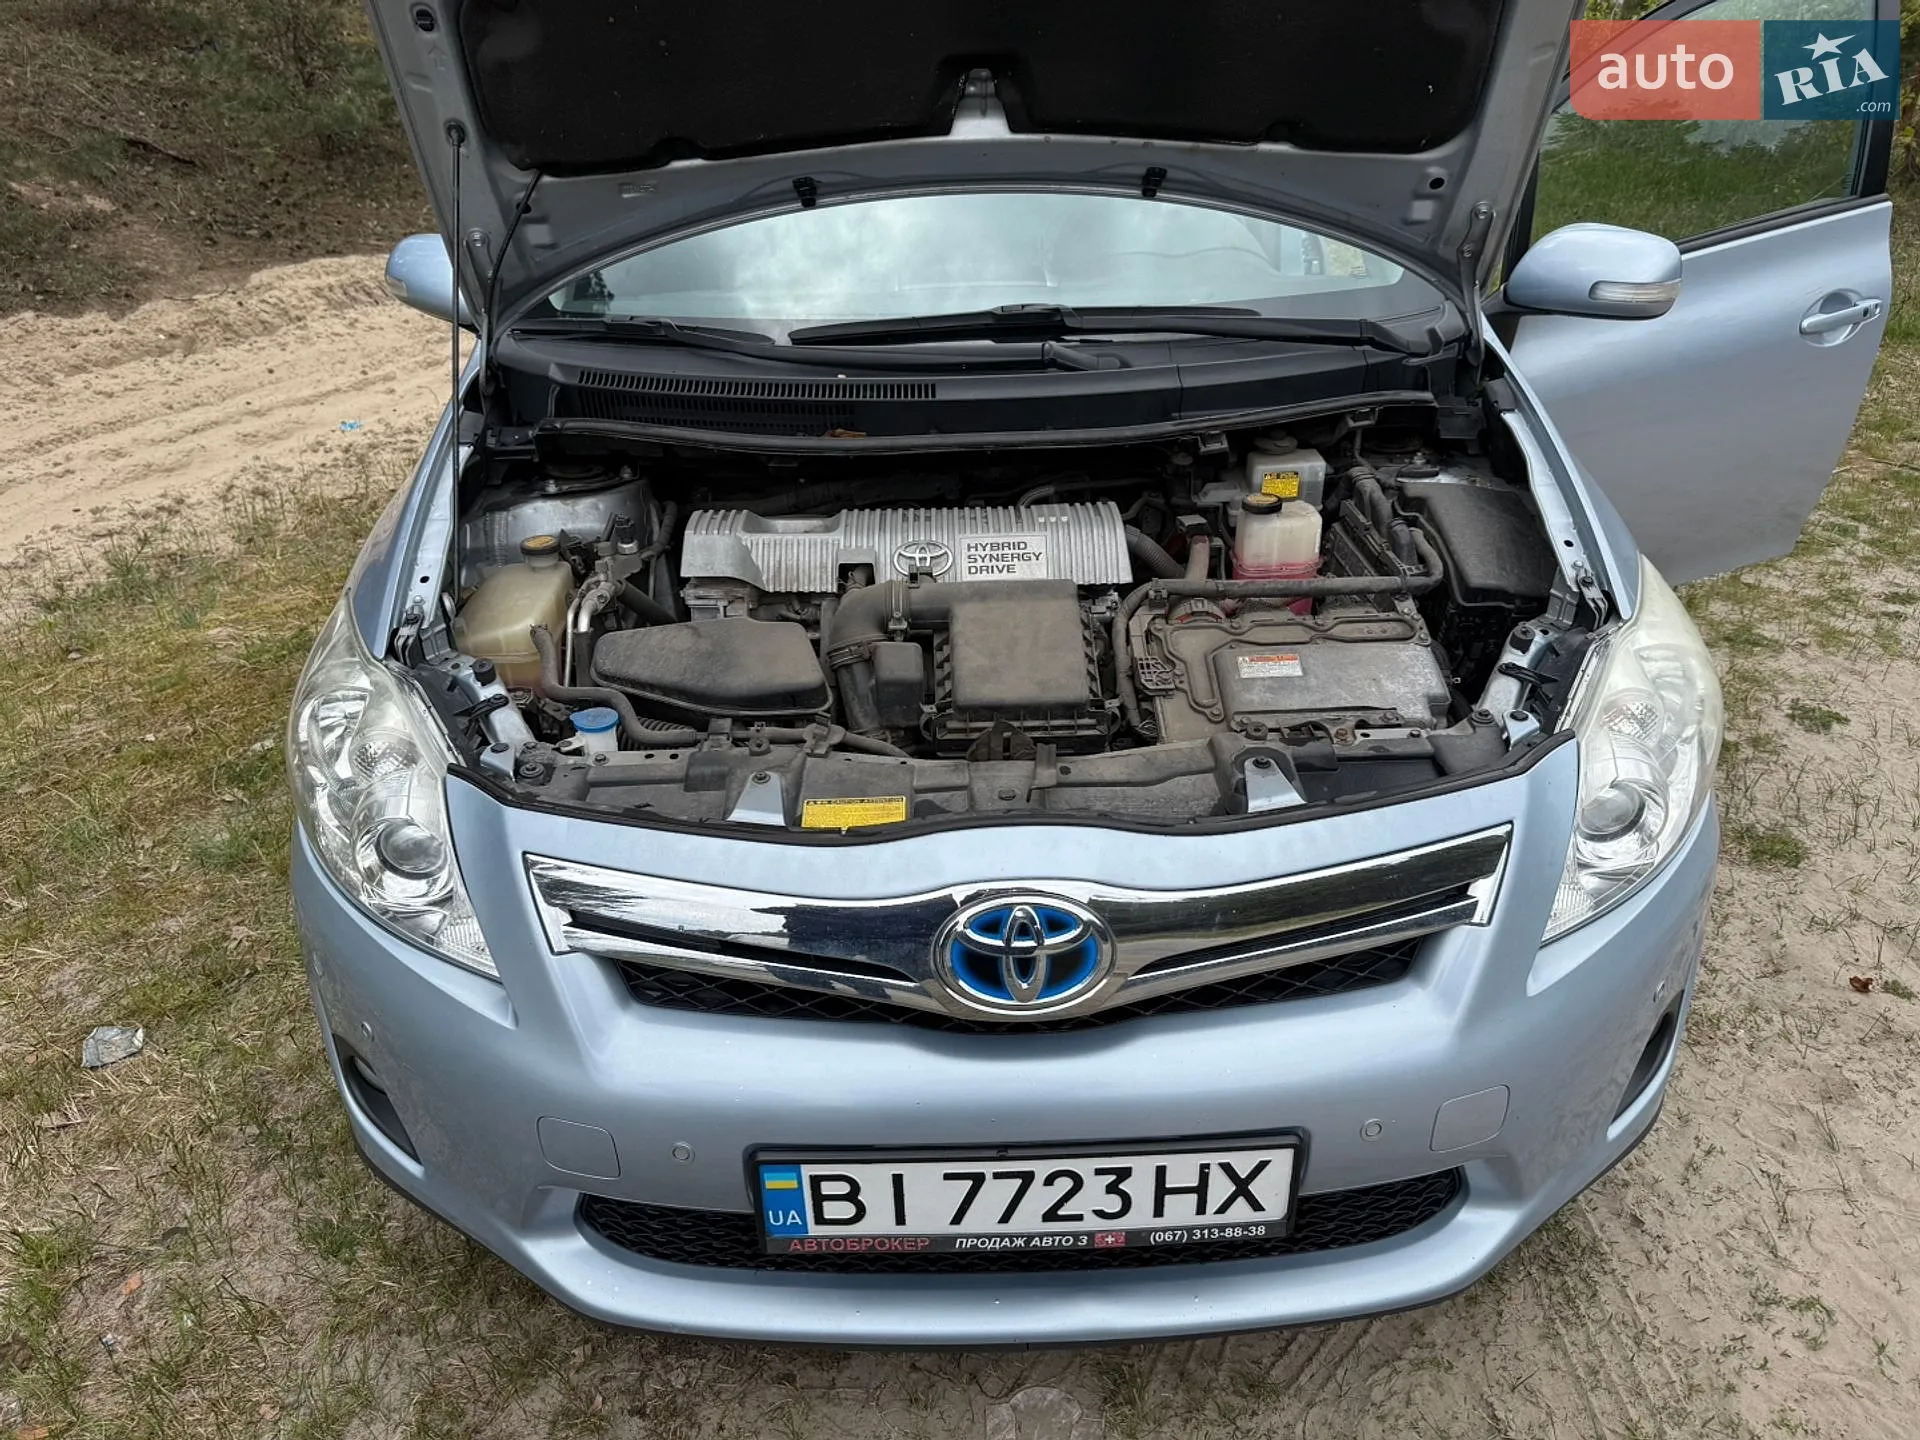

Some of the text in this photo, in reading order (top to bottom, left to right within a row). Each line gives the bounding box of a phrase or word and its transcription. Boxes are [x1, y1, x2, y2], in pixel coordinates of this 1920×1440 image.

[966, 541, 1028, 552] HYBRID
[967, 552, 1043, 564] SYNERGY
[967, 564, 1017, 575] DRIVE
[942, 1166, 1133, 1226] 7723
[768, 1210, 802, 1226] UA
[788, 1237, 930, 1252] АВТОБРОКЕР
[955, 1237, 1027, 1250] ПРОДАЖ
[1029, 1235, 1074, 1249] АВТО
[1149, 1230, 1188, 1245] (067)
[1192, 1225, 1266, 1240] 313-88-38
